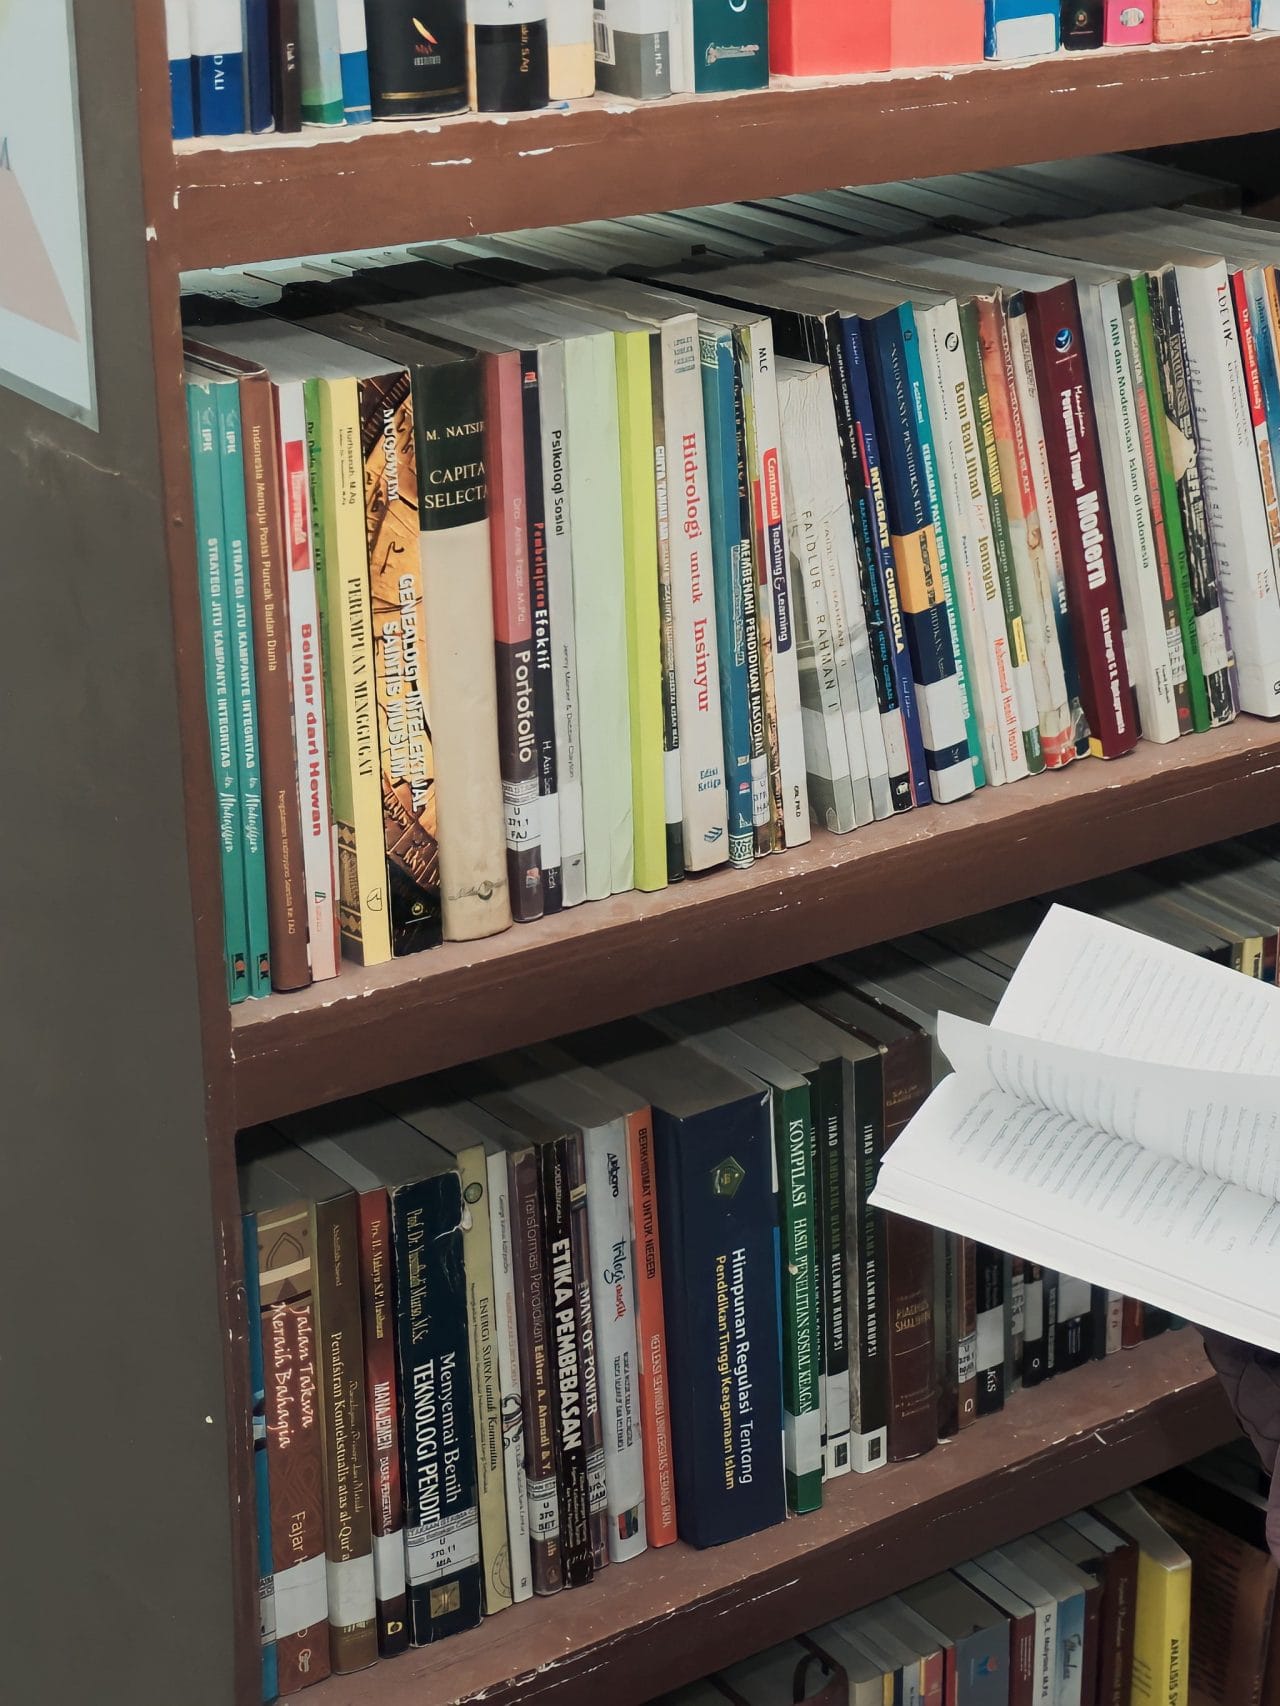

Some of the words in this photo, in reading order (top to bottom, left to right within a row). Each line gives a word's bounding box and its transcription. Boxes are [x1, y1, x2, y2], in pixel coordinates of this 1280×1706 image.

[758, 347, 767, 373] MLC
[1110, 318, 1119, 346] IAIN
[1114, 349, 1122, 373] dan
[1250, 369, 1261, 410] Effendy
[202, 428, 211, 451] IPK
[226, 431, 235, 453] IPK
[426, 430, 441, 441] M.
[1118, 376, 1132, 452] Modernisasi
[252, 425, 262, 479] Indonesia
[551, 430, 563, 493] Psikologi
[903, 431, 918, 497] PENDIDIKAN
[914, 500, 922, 524] KITA
[922, 443, 936, 502] KERAGAMAN
[1129, 458, 1137, 491] Islam
[256, 482, 265, 523] Menuju
[682, 433, 700, 539] Hidrologi
[767, 457, 779, 520] Contextual
[954, 381, 967, 419] Bom
[978, 536, 995, 600] Jenayah
[1061, 389, 1077, 453] Perguruan
[1077, 490, 1105, 590] Modern
[1133, 494, 1141, 505] di
[259, 527, 269, 557] Posisi
[554, 497, 563, 535] Sosial
[1136, 507, 1148, 568] Indonesia
[208, 538, 220, 595] STRATEGI
[232, 540, 243, 598] STRATEGI
[533, 522, 545, 607] Pembelajaran
[690, 551, 702, 604] untuk
[740, 539, 753, 614] MEMBENAHI
[772, 526, 782, 575] Teaching
[870, 466, 888, 549] INTEGRATE
[885, 567, 903, 654] CURRICULA
[262, 561, 272, 600] Puncak
[802, 510, 820, 589] FAIDLUR
[818, 615, 834, 689] RAHMAN
[1056, 581, 1066, 614] KKN
[211, 600, 221, 626] JITU
[236, 602, 245, 627] JITU
[264, 604, 274, 636] Badan
[348, 578, 364, 675] PEREMPUAN
[535, 609, 549, 669] Efektif
[777, 591, 787, 642] Learning
[214, 629, 226, 694] KAMPANYE
[238, 631, 249, 696] KAMPANYE
[267, 640, 276, 671] Dunia
[301, 623, 313, 705] Belajar
[382, 622, 399, 696] SAINTIS
[693, 618, 708, 712] Insinyur
[746, 617, 759, 697] PENDIDIKAN
[218, 698, 230, 767] INTEGRITAS
[242, 699, 254, 768] INTEGRITAS
[306, 711, 318, 754] dari
[354, 681, 371, 776] MENGGUGAT
[515, 650, 533, 763] Portofolio
[752, 700, 762, 755] NASIONAL
[387, 702, 405, 778] MUSLIM
[405, 691, 426, 812] INTELEKTUAL
[309, 761, 320, 836] Hewan
[828, 1116, 837, 1145] JIHAD
[864, 1124, 872, 1153] JIHAD
[638, 1128, 650, 1196] BERKHIDMAT
[789, 1118, 805, 1207] KOMPILASI
[525, 1192, 538, 1270] Transformasi
[642, 1200, 652, 1237] UNTUK
[794, 1218, 807, 1254] HASIL
[552, 1237, 572, 1306] ETIKA
[645, 1239, 655, 1279] NEGERI
[831, 1253, 841, 1303] MELAWAN
[866, 1260, 875, 1311] MELAWAN
[479, 1298, 489, 1341] ENERGI
[530, 1273, 542, 1343] Pendidikan
[579, 1287, 591, 1326] MAN
[716, 1254, 728, 1331] Pendidikan
[731, 1247, 745, 1339] Himpunan
[794, 1255, 808, 1327] PENELITIAN
[272, 1302, 291, 1367] Meraih
[289, 1305, 310, 1360] Jalan
[582, 1329, 593, 1349] OF
[717, 1332, 730, 1375] Tinggi
[797, 1329, 810, 1368] SOSIAL
[833, 1307, 842, 1350] KORUPSI
[867, 1314, 876, 1357] KORUPSI
[331, 1332, 343, 1397] Penafsiran
[482, 1345, 491, 1382] SURYA
[534, 1344, 544, 1384] Editor:
[556, 1308, 580, 1450] PEMBEBASAN
[584, 1355, 597, 1417] POWER
[734, 1341, 751, 1414] Regulasi
[271, 1369, 293, 1448] Bahagia
[299, 1362, 314, 1427] Takwa
[374, 1381, 391, 1449] MANAJEMEN
[414, 1359, 436, 1460] TEKNOLOGI
[439, 1351, 456, 1445] Menyemai
[485, 1383, 496, 1414] untuk
[537, 1389, 545, 1401] A.
[719, 1377, 732, 1452] Keagamaan
[334, 1400, 347, 1482] Kontekstualis
[488, 1415, 497, 1470] Komunitas
[542, 1462, 550, 1474] Y.
[739, 1420, 753, 1483] Tentang
[338, 1485, 347, 1509] atas
[444, 1448, 460, 1503] Benih
[725, 1455, 735, 1489] Islam
[288, 1511, 305, 1551] Fajar
[1169, 1639, 1179, 1691] ANALISIS
